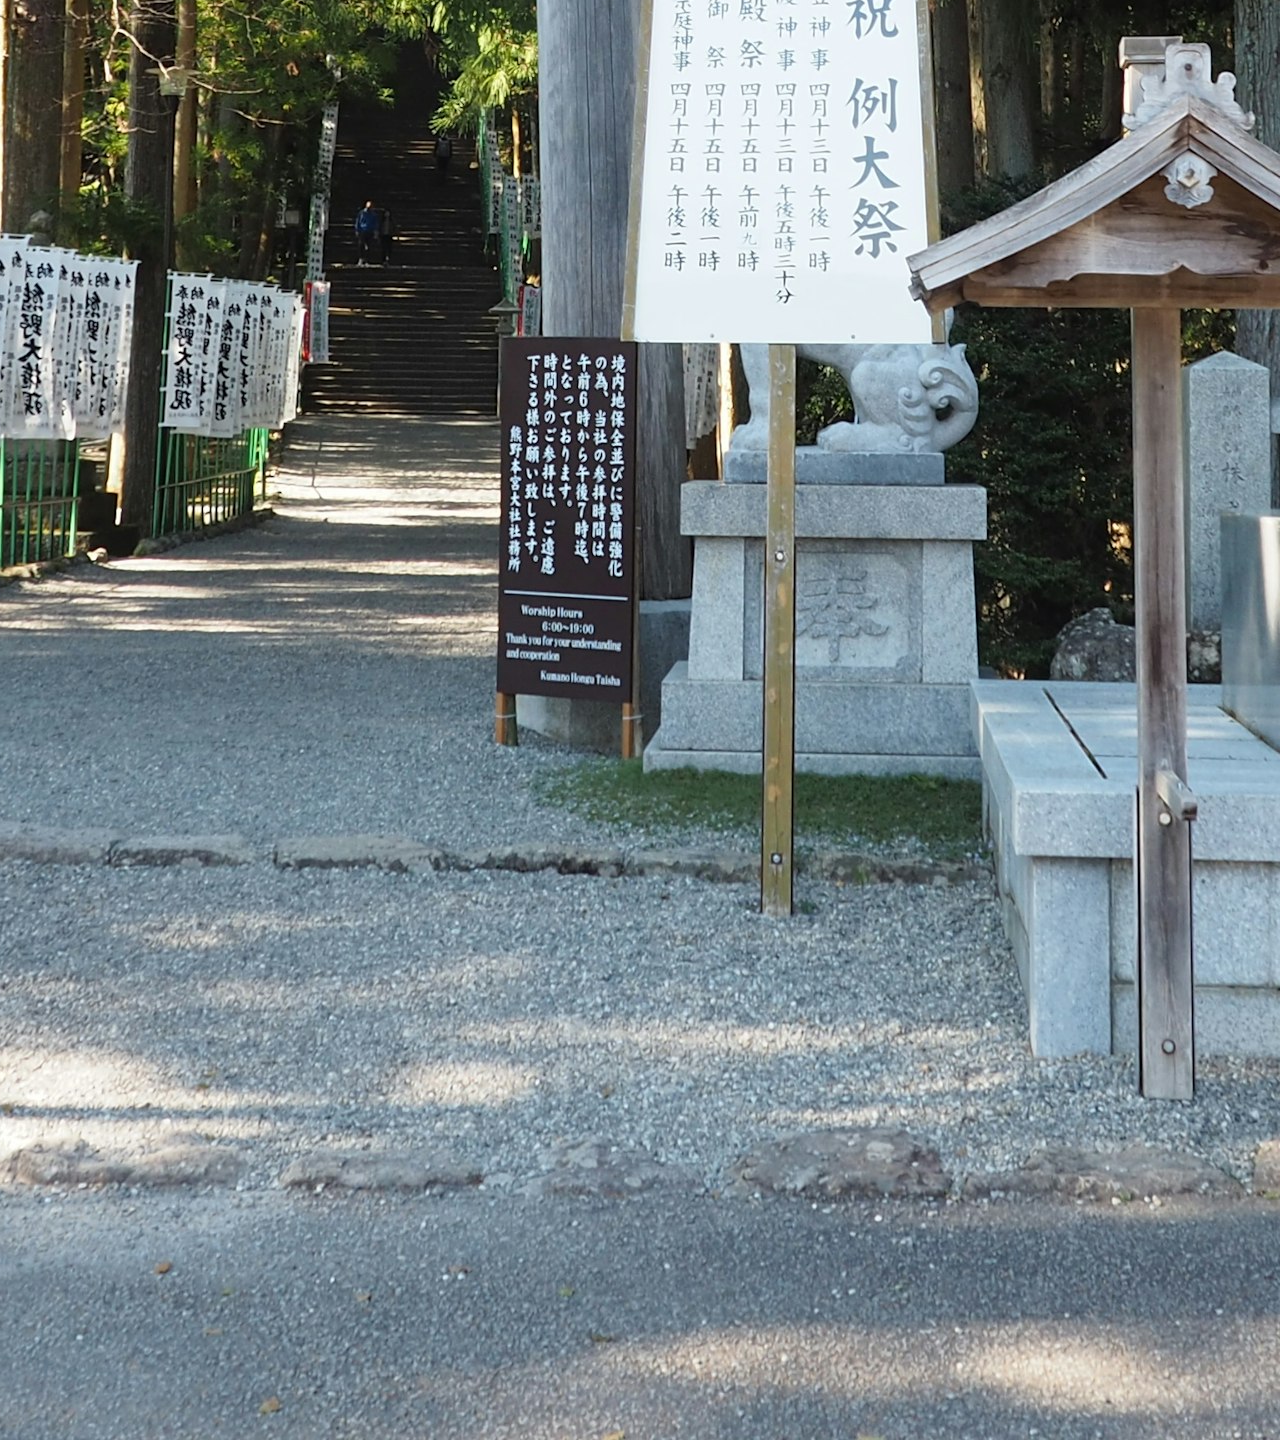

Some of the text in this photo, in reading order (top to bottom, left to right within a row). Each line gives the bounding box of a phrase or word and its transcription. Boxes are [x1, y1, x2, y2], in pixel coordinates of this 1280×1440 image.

[667, 83, 690, 173] 四月十五日
[703, 83, 726, 174] 四月十五日
[739, 83, 761, 174] 四月十五日
[775, 83, 797, 174] 四月十三日
[809, 83, 832, 174] 四月十三日
[846, 77, 907, 259] 例大祭
[664, 184, 689, 272] 午後二時
[698, 184, 722, 272] 午後一時
[738, 184, 760, 272] 午前九時
[774, 184, 797, 303] 午後五時三十分
[809, 184, 831, 272] 午後一時
[524, 355, 540, 563] 下さる様お願い致します。
[558, 356, 573, 507] となっております。
[608, 355, 626, 578] 境内地保全並びに警備強化
[508, 426, 522, 573] 熊野本宮大社社務所
[506, 633, 621, 651] Thank you for your understanding
[506, 648, 559, 661] and cooperation
[521, 604, 583, 618] Worship Hours
[540, 670, 620, 686] Kumano Hongu Taisha
